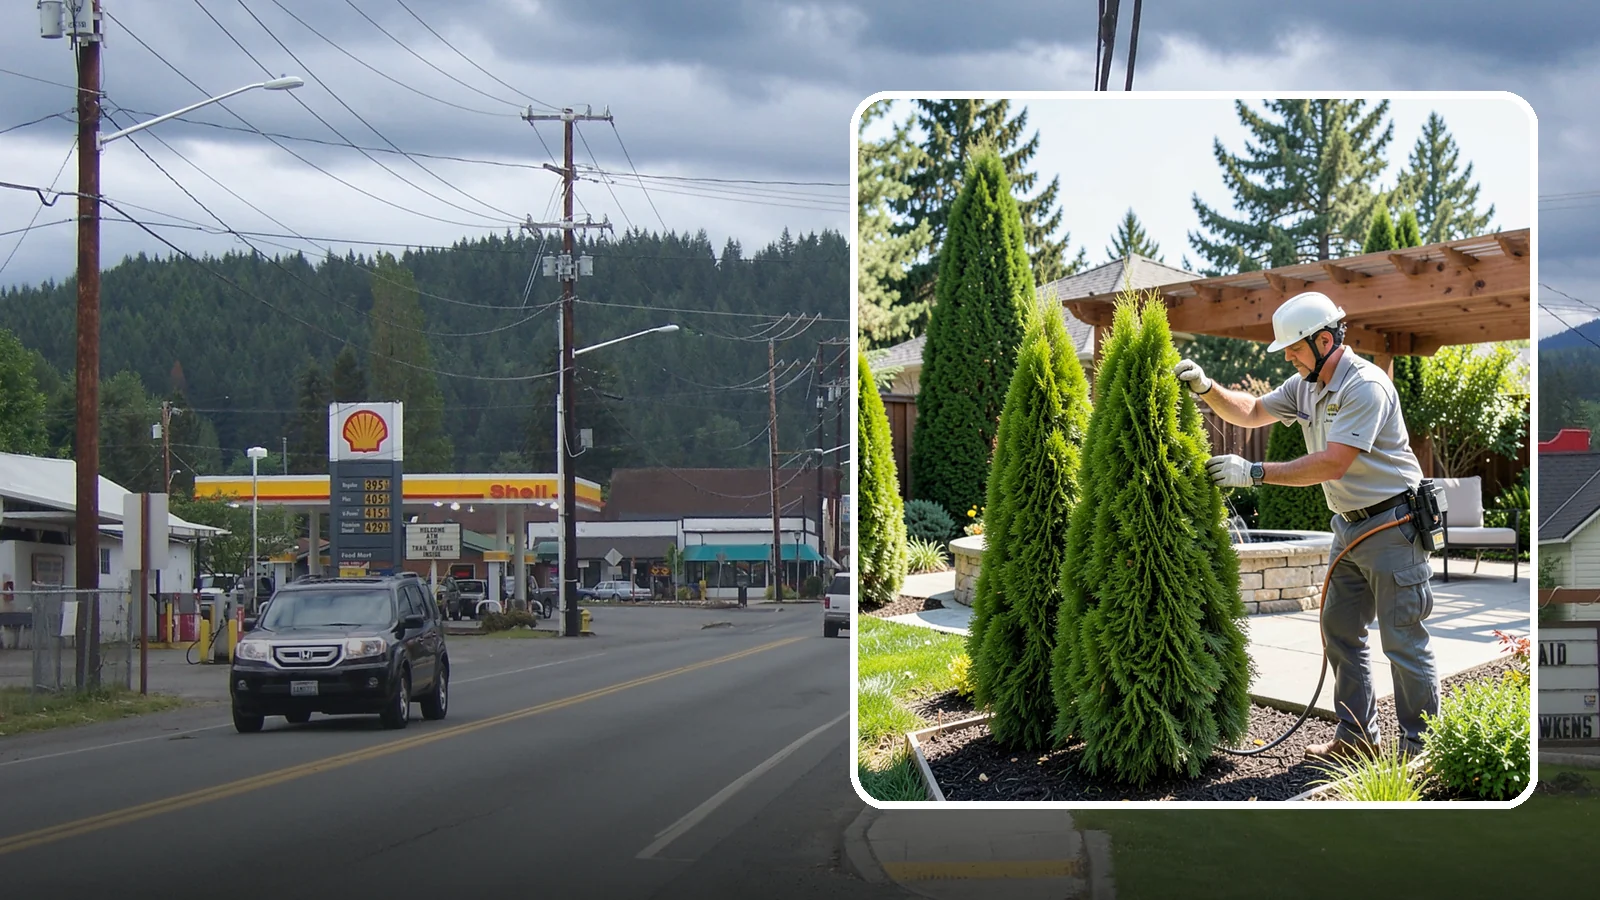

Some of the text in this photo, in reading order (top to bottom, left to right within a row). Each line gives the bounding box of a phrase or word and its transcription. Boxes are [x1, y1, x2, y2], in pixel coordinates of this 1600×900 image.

[365, 480, 383, 490] 395
[490, 484, 547, 499] Shell
[365, 494, 383, 504] 405
[365, 508, 383, 518] 415
[365, 522, 383, 532] 429
